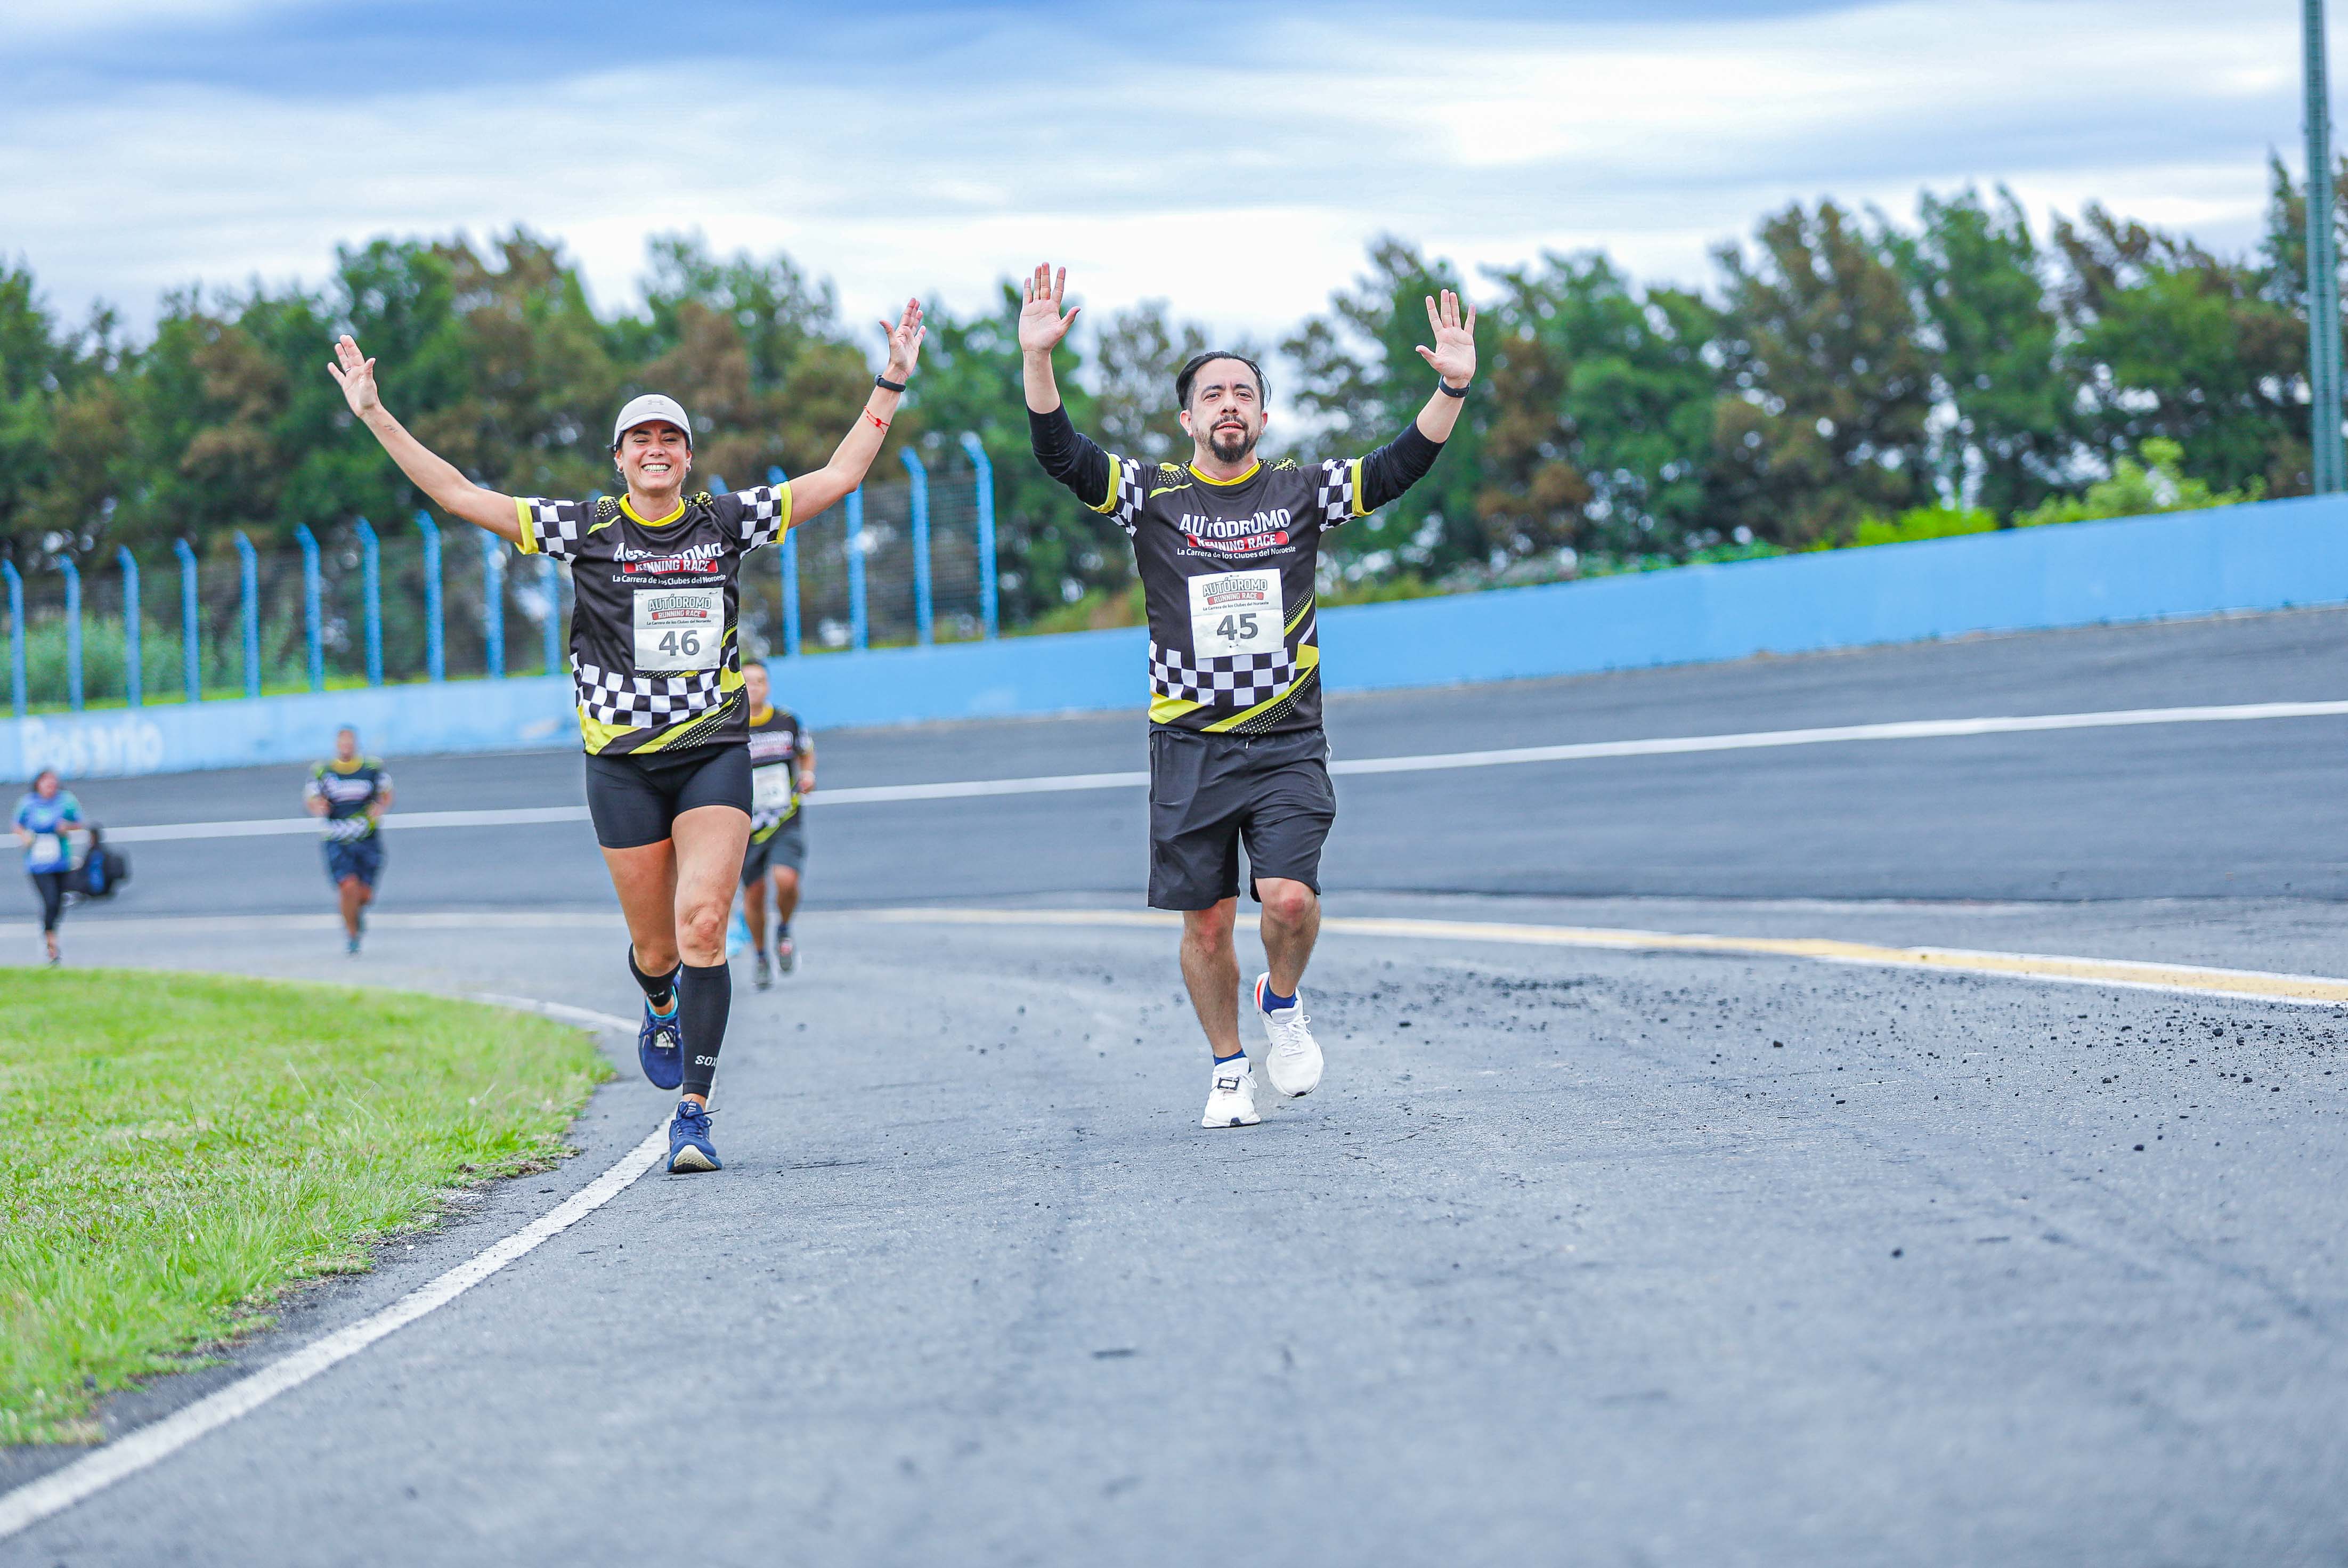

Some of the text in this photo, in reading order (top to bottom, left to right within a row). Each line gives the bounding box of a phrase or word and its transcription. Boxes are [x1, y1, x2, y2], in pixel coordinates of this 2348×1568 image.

[1179, 508, 1291, 538] AUTÓDROMO
[1197, 534, 1277, 551] RUNNING RACE
[613, 542, 725, 562] AUTOMO
[1186, 548, 1212, 557] Carrera
[1271, 546, 1296, 555] Noroeste
[635, 559, 710, 573] RUNNING RACE
[702, 574, 726, 583] Noroeste
[1203, 577, 1268, 597] AUTÓDROMO
[648, 594, 712, 612] AUTÓDROMO
[1214, 592, 1240, 603] RUNNING
[658, 610, 685, 619] RUNNING
[1216, 613, 1258, 640] 45
[659, 630, 700, 656] 46
